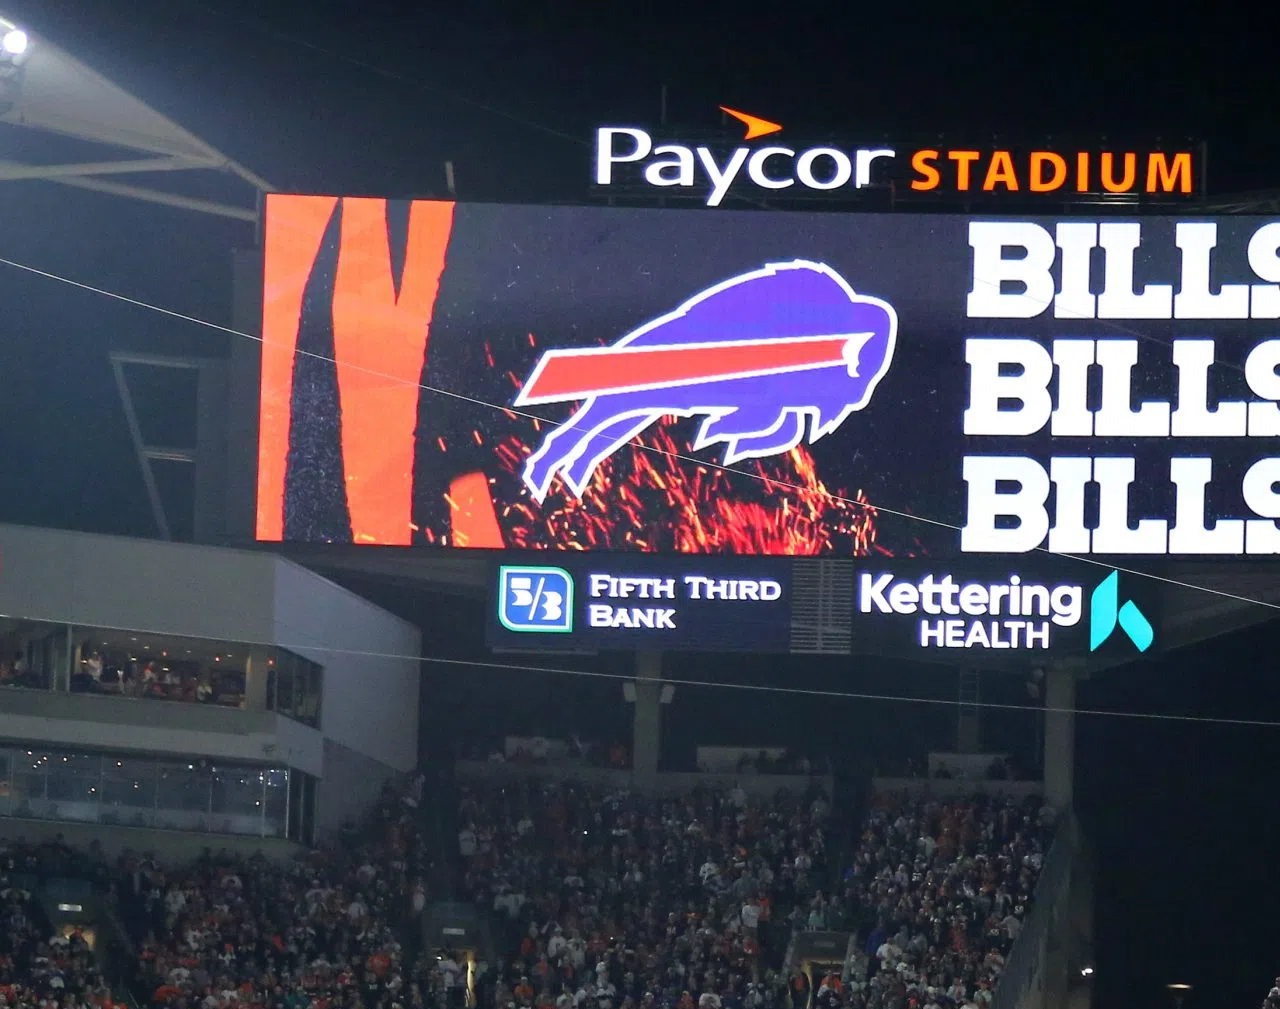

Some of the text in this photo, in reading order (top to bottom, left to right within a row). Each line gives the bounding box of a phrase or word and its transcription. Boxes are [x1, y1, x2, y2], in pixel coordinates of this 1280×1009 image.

[594, 124, 1194, 205] Paycor STADIUM
[860, 573, 1083, 626] Kettering
[920, 619, 1050, 649] HEALTH
